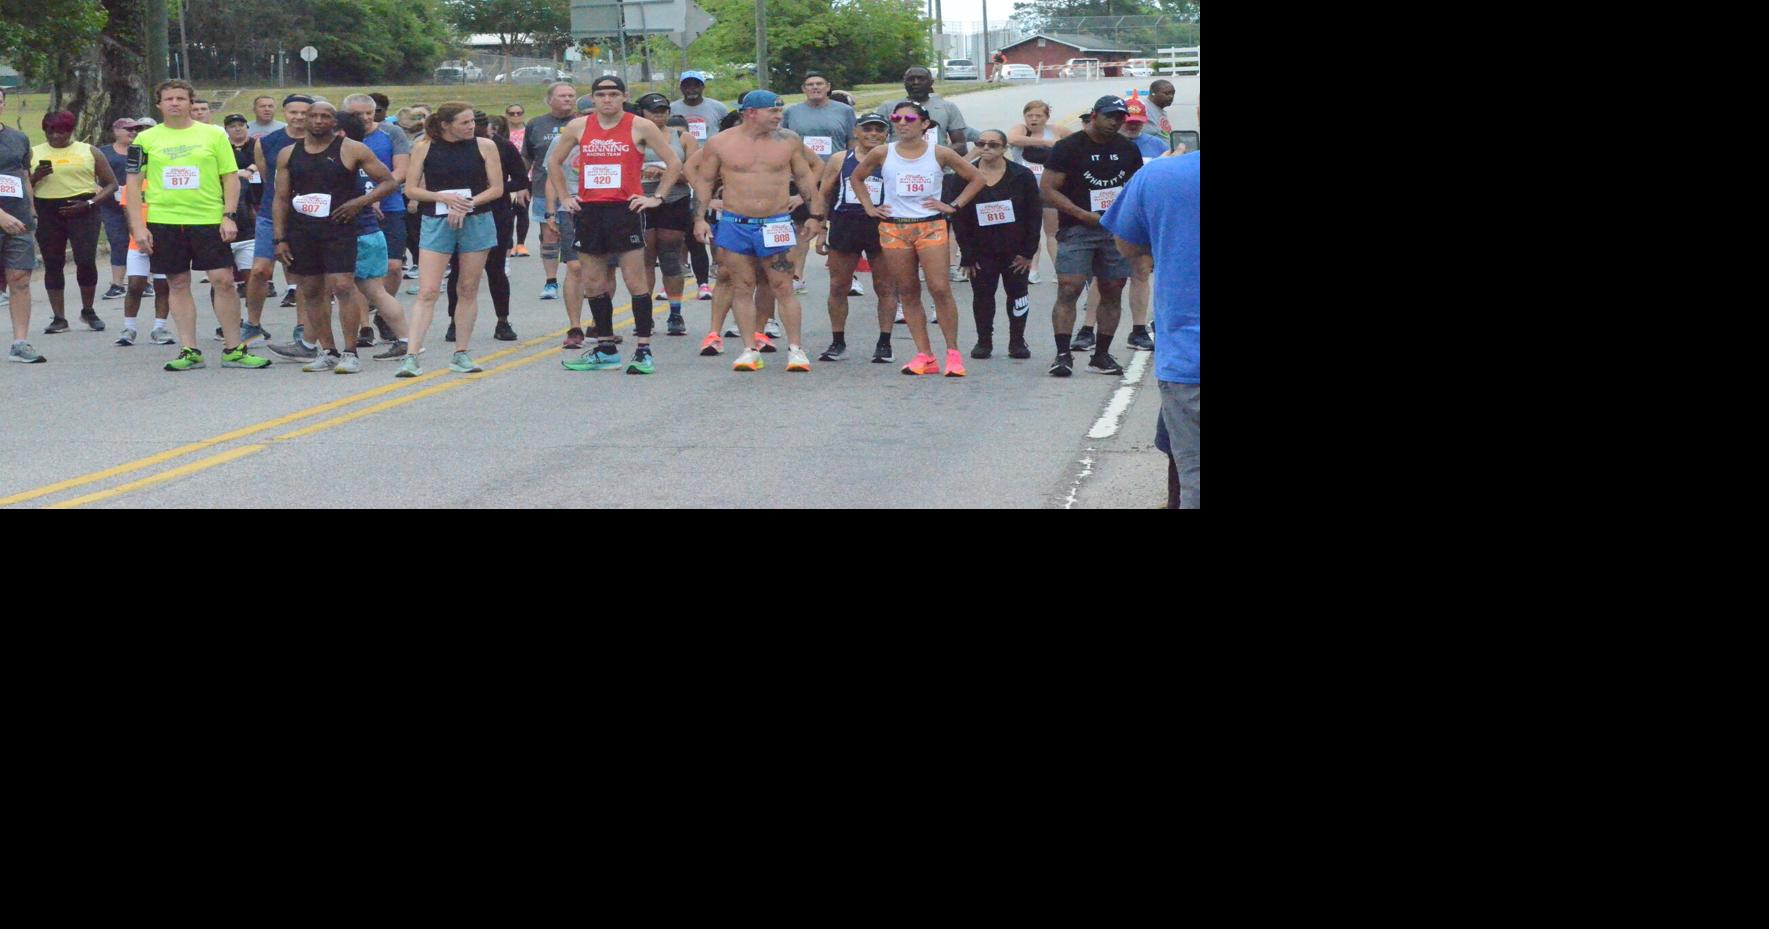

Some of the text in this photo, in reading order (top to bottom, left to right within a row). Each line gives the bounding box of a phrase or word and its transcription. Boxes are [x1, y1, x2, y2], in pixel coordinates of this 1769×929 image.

[172, 177, 190, 186] 817
[593, 176, 611, 185] 420
[1083, 170, 1109, 187] WHAT
[1110, 177, 1118, 186] IT
[907, 184, 924, 192] 184
[303, 204, 320, 213] 807
[987, 212, 1005, 221] 818
